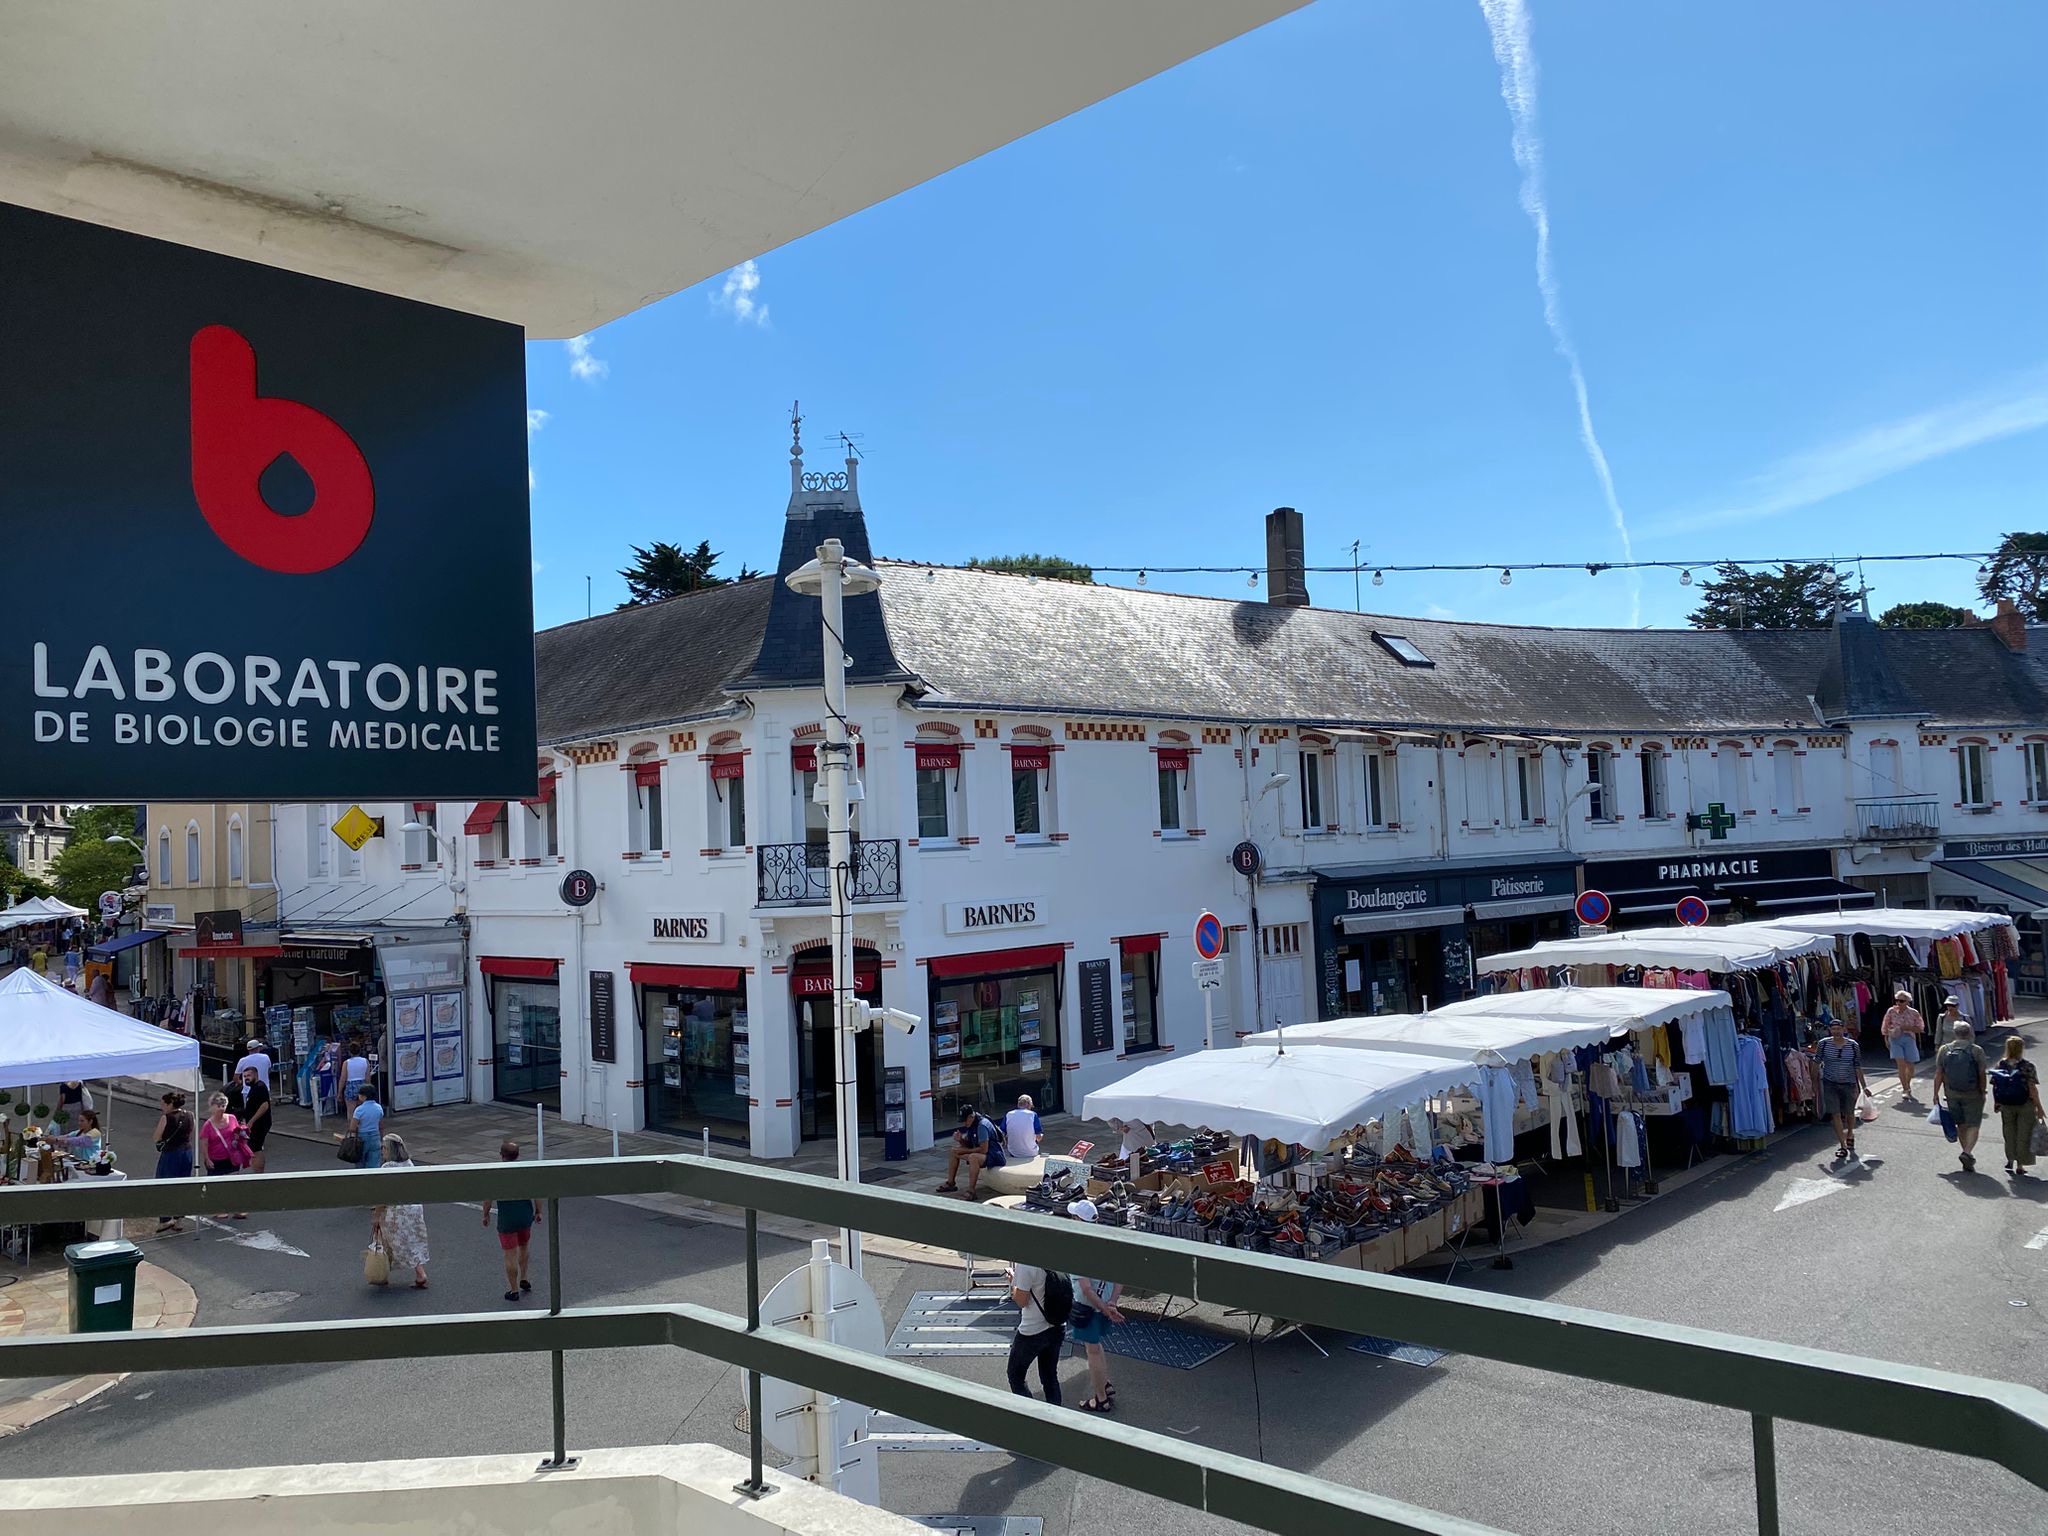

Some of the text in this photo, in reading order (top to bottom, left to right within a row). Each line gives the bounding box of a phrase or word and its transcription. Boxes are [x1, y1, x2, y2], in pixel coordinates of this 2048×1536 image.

[33, 641, 500, 716] LABORATOIRE
[34, 710, 501, 752] DE BIOLOGIE MEDICALE
[920, 757, 952, 767] BARNES
[1014, 759, 1043, 768] BARNES
[1160, 760, 1184, 769] BARNES
[715, 767, 740, 778] BARNES
[1965, 838, 2048, 856] Bistrot des Hall
[1242, 850, 1252, 867] B
[1658, 859, 1760, 880] PHARMACIE
[574, 879, 587, 897] B
[1490, 875, 1545, 898] Pâtisserie
[1346, 884, 1428, 911] Boulangerie
[963, 901, 1036, 928] BARNES
[212, 931, 234, 941] Boucherie
[653, 917, 708, 939] BARNES
[804, 976, 863, 992] BARS
